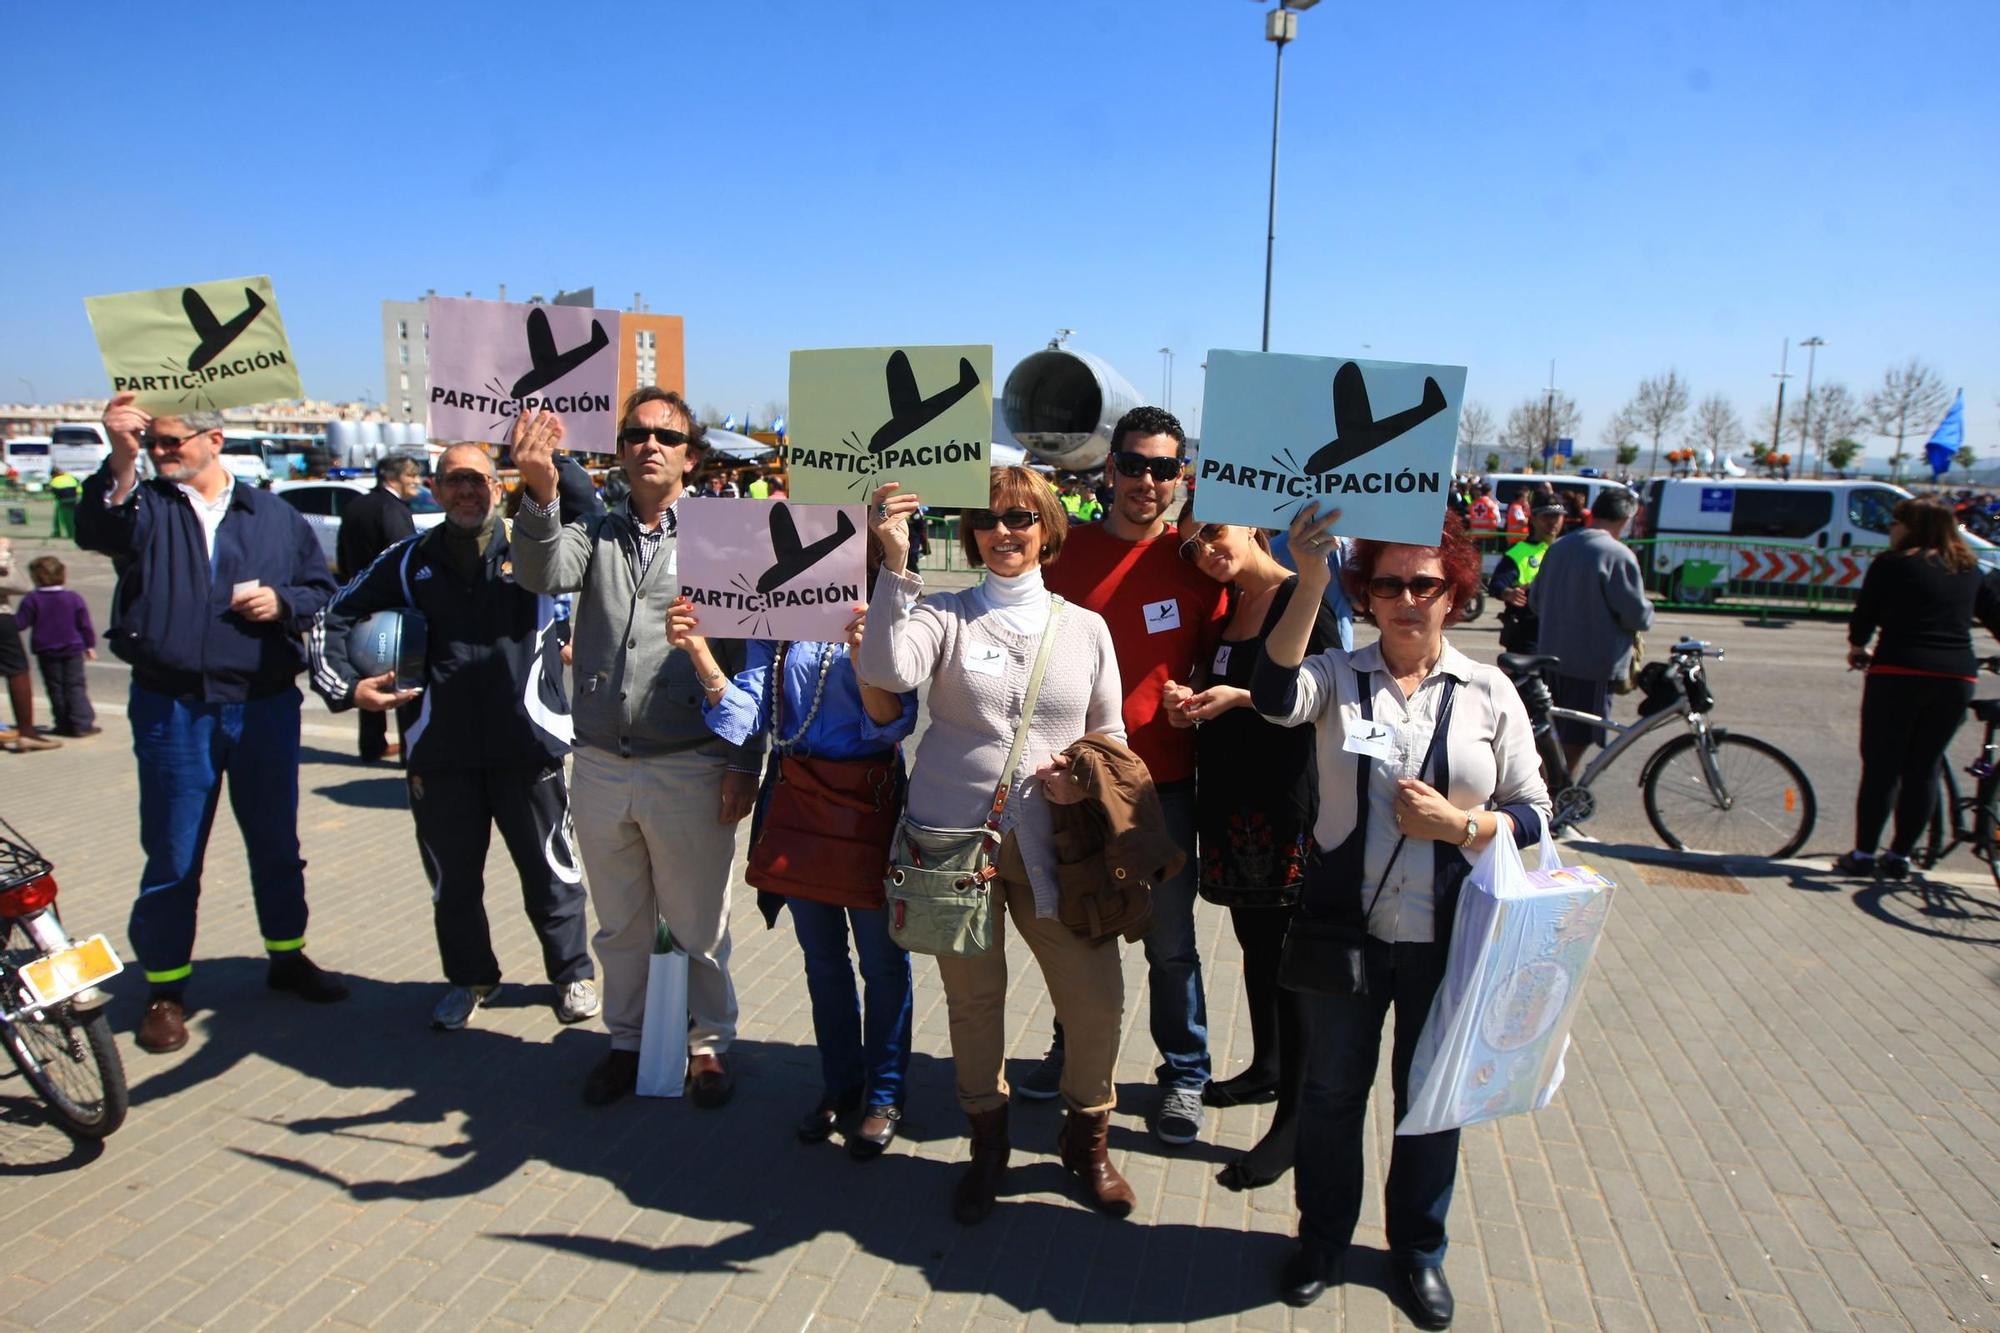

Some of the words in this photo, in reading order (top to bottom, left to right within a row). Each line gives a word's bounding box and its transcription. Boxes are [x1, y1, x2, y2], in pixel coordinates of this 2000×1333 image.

[114, 350, 287, 391] PARTICIPACIÓN
[431, 387, 610, 418] PARTICIPACIÓN
[790, 440, 982, 475] PARTICIPACIÓN
[1201, 459, 1440, 499] PARTICIPACIÓN
[681, 582, 859, 613] PARTICIPACIÓN
